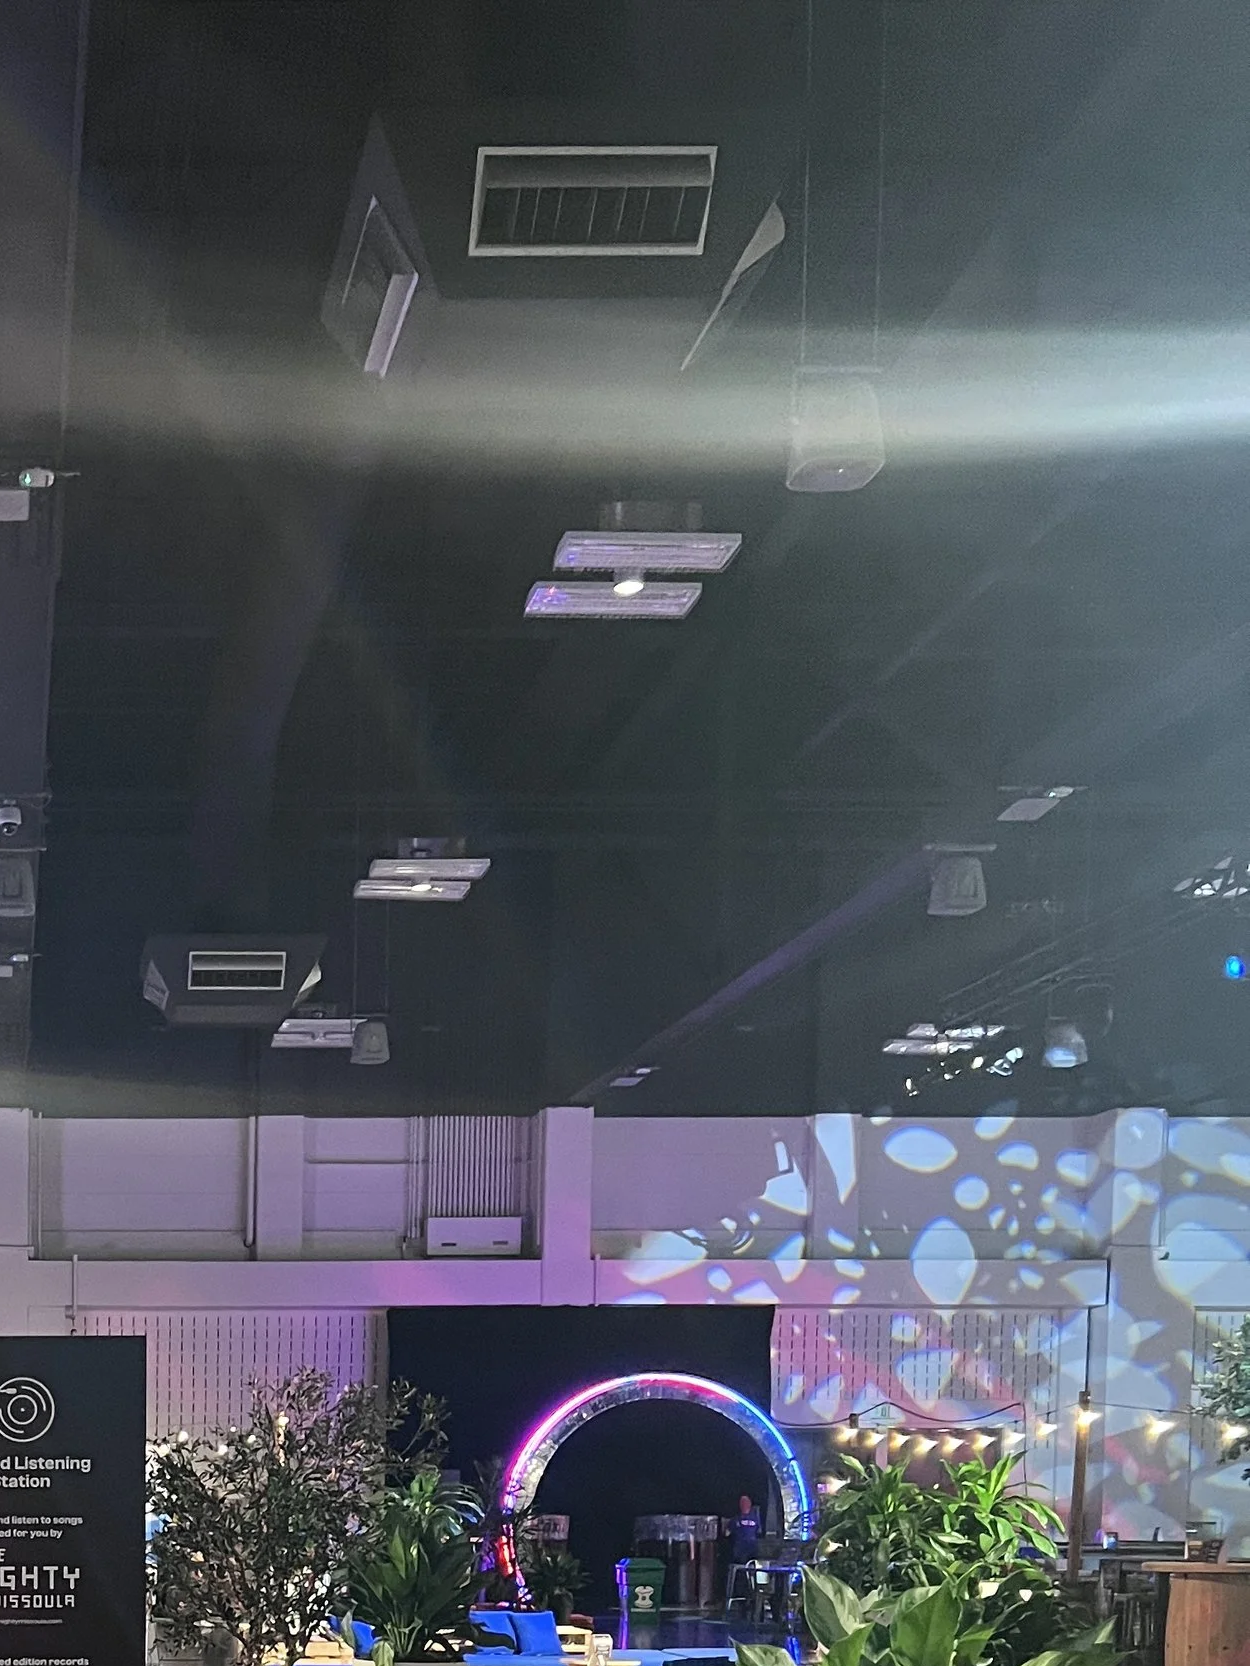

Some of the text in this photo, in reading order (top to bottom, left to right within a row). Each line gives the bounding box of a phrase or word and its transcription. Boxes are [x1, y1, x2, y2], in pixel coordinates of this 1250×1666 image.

[14, 1456, 91, 1473] Listening
[11, 1516, 39, 1525] listen
[40, 1516, 52, 1525] to
[52, 1517, 83, 1526] songs
[13, 1529, 28, 1538] for
[29, 1531, 49, 1539] you
[49, 1529, 63, 1539] by
[12, 1657, 47, 1666] edition
[48, 1657, 90, 1666] records
